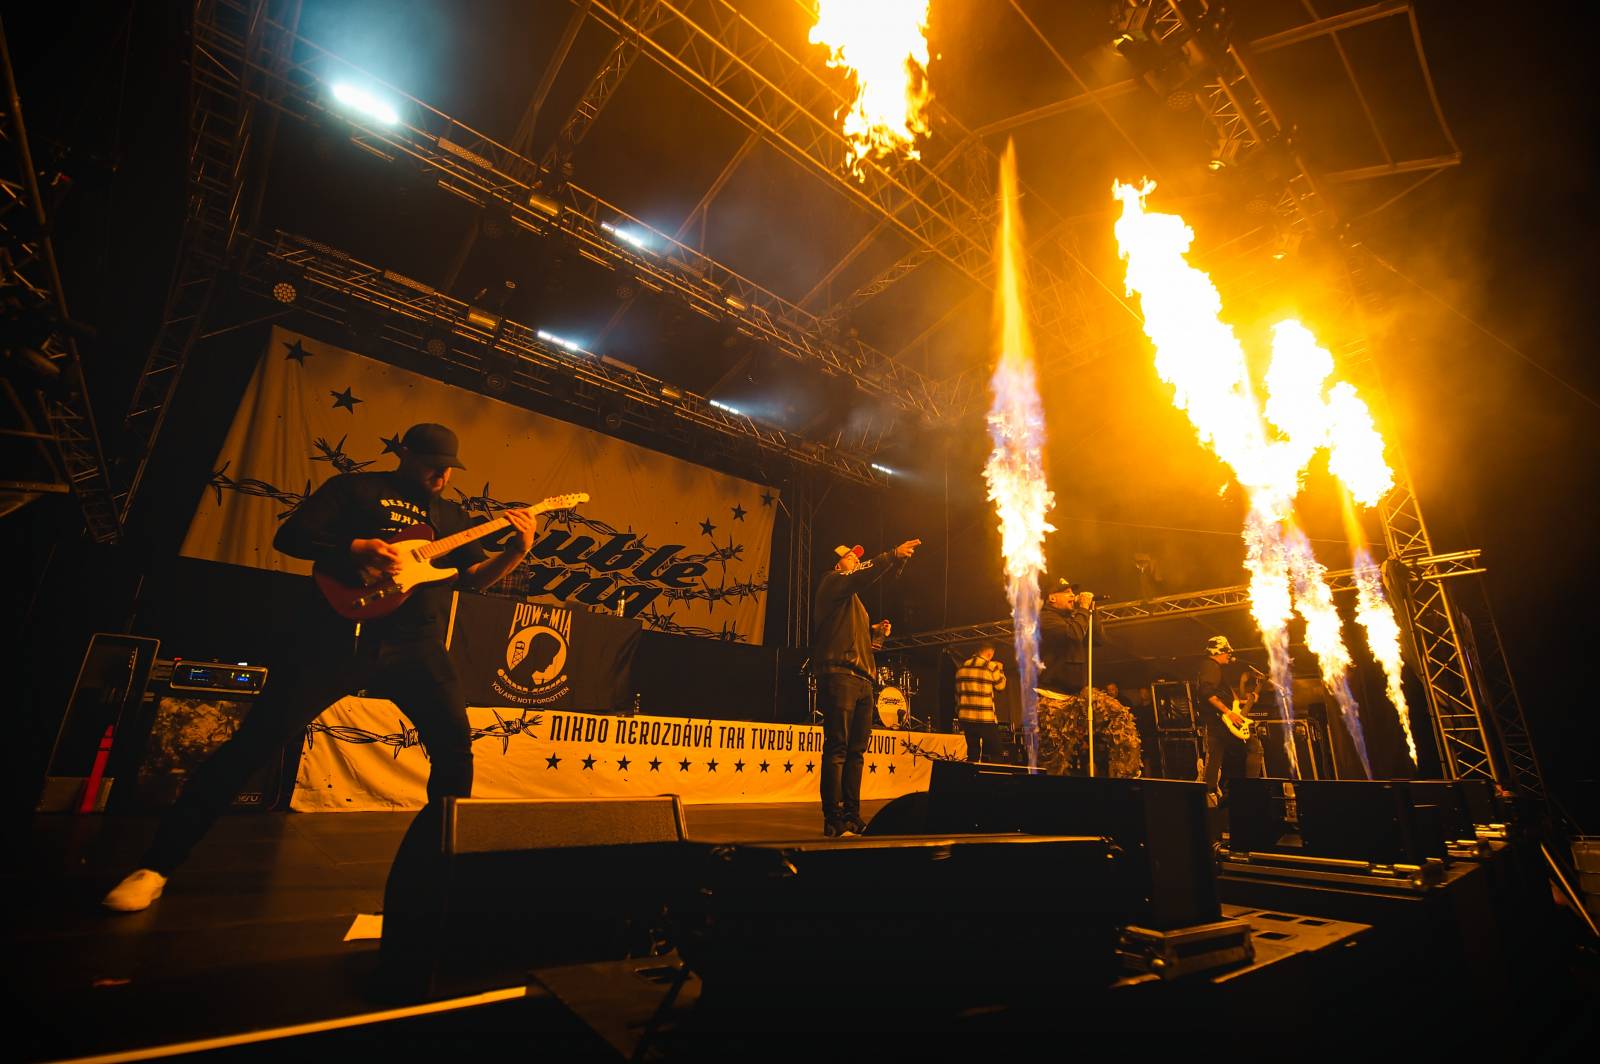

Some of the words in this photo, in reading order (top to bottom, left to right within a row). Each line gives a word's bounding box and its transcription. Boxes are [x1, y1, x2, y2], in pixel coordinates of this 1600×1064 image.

[380, 498, 428, 517] DESTRO
[390, 511, 420, 526] WHA
[508, 602, 544, 638] POW
[549, 607, 572, 647] MIA
[491, 680, 504, 695] YOU
[502, 690, 516, 702] ARE
[532, 686, 569, 704] FORGOTTEN
[550, 715, 609, 743] NIKDO
[615, 718, 713, 748] NEROZDÁVÁ
[719, 726, 745, 749] TAK
[751, 726, 793, 751] TVRDÝ
[798, 726, 824, 752] RÁN
